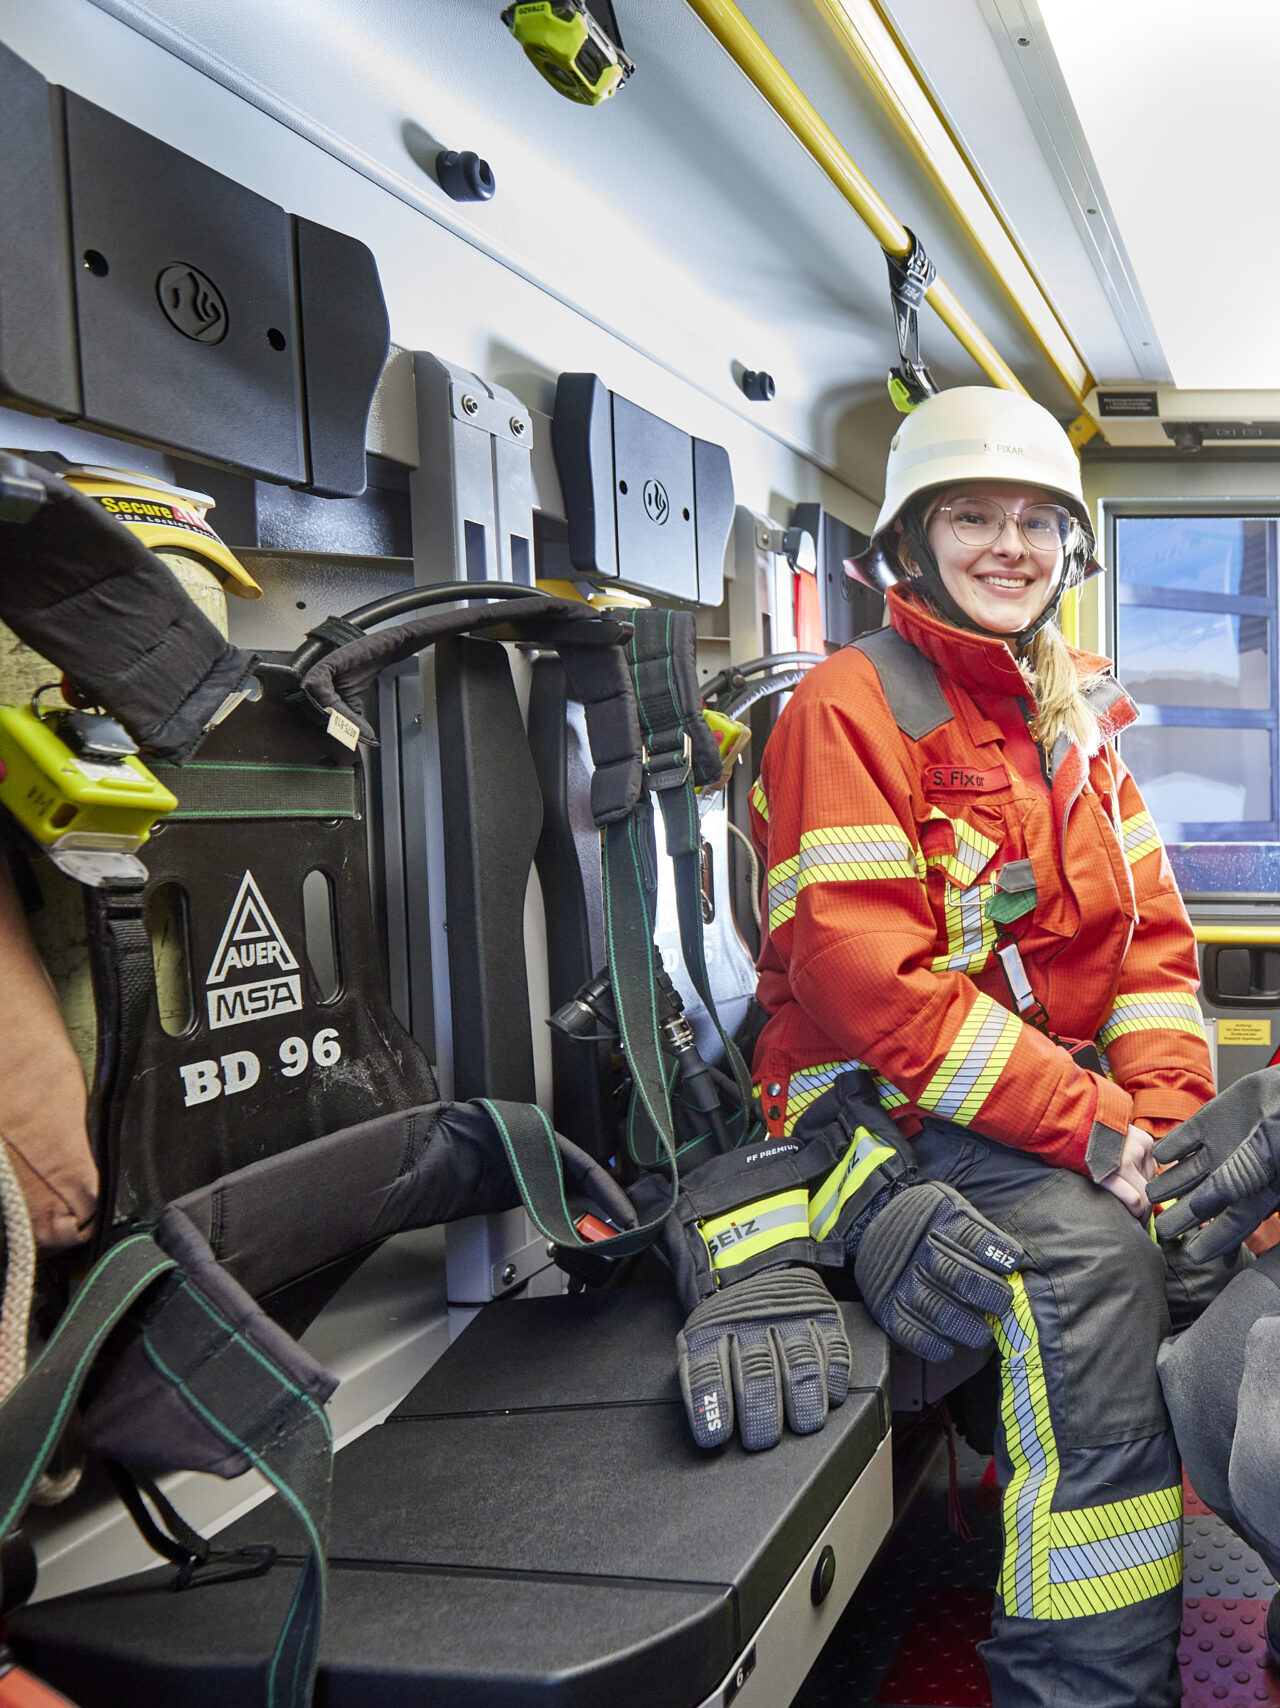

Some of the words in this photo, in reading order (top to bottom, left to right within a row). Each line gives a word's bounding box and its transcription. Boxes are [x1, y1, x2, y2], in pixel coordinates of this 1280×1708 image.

[996, 444, 1024, 456] FIXAR
[220, 940, 287, 969] AUER
[216, 981, 297, 1022] MSA
[180, 1050, 261, 1107] BD
[278, 1028, 342, 1077] 96
[746, 1153, 758, 1163] FF
